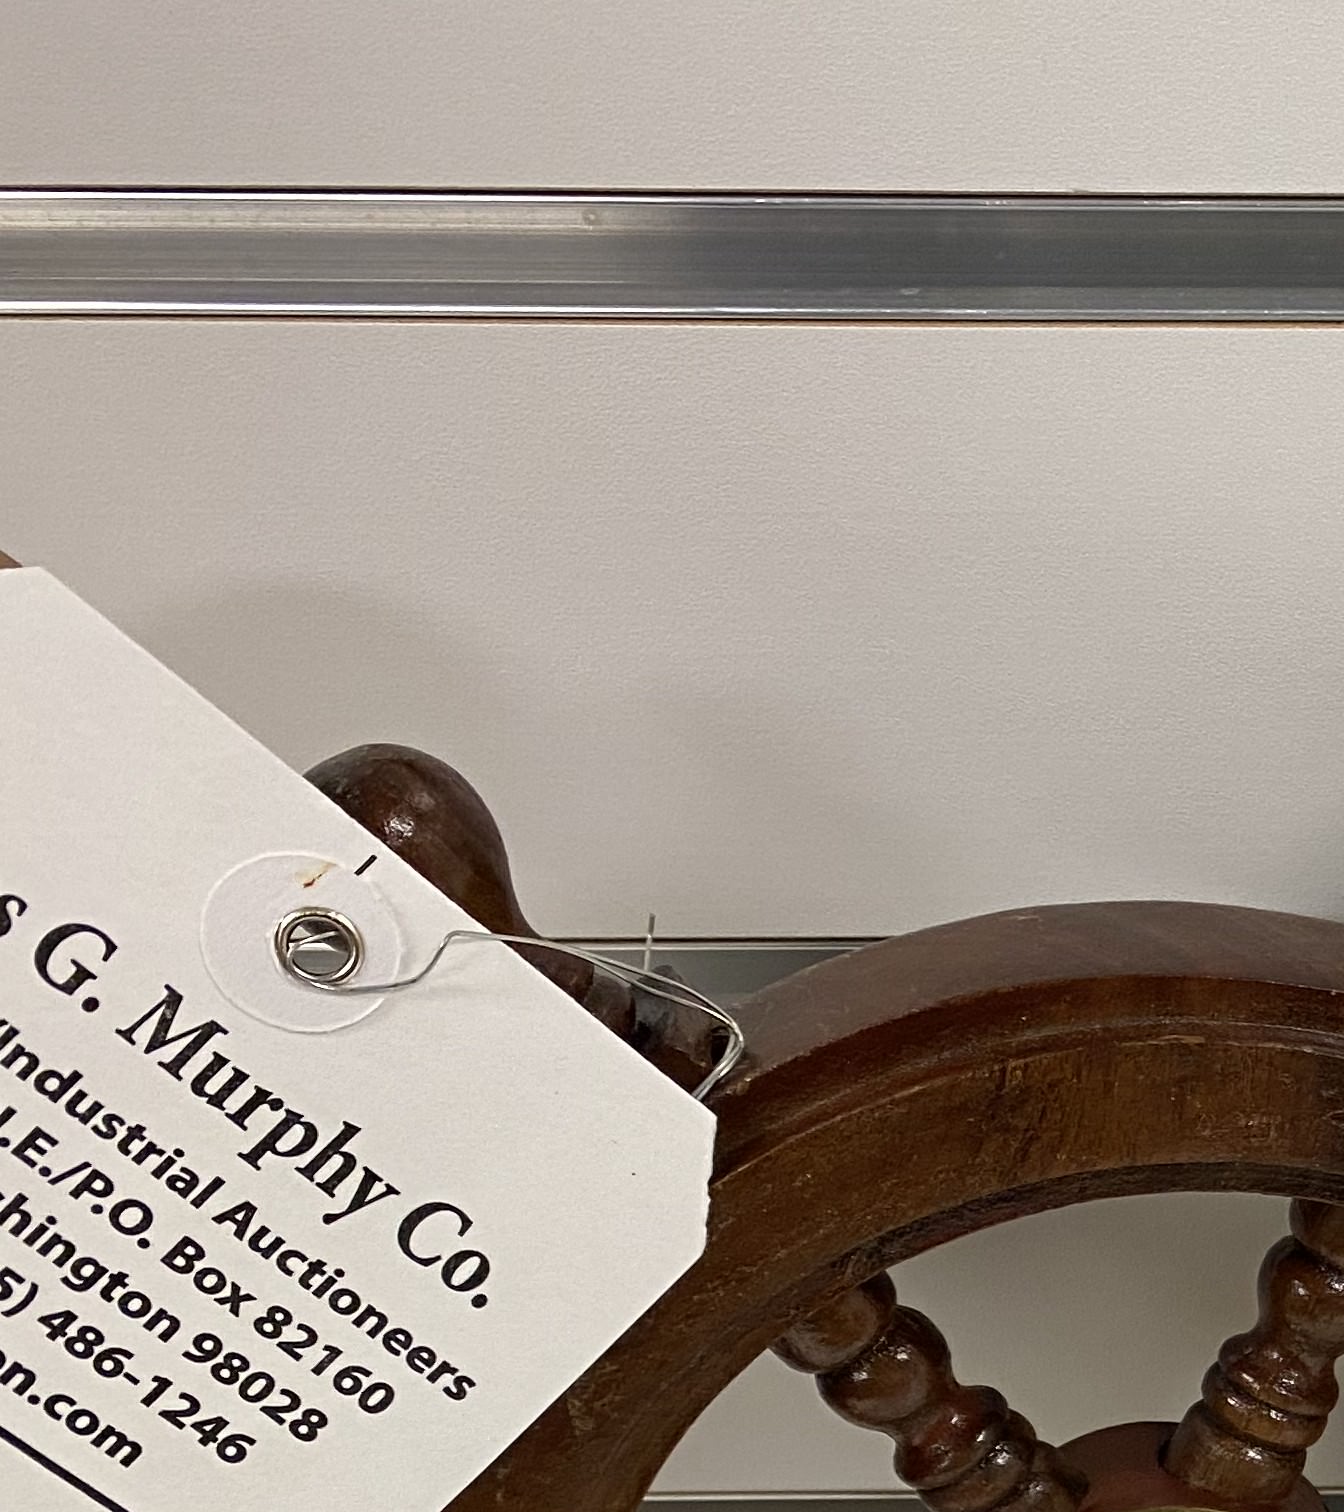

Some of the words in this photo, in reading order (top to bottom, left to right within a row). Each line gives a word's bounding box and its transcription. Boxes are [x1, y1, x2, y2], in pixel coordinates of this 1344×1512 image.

[34, 923, 118, 1013] G.
[115, 983, 401, 1226] Murphy
[397, 1201, 488, 1309] Co.
[0, 1192, 181, 1343] hington
[181, 1332, 328, 1442] 98028
[37, 1309, 257, 1464] 486-1246
[160, 1235, 258, 1318] Box
[253, 1305, 395, 1414] 82160
[211, 1200, 476, 1401] Auctioneers
